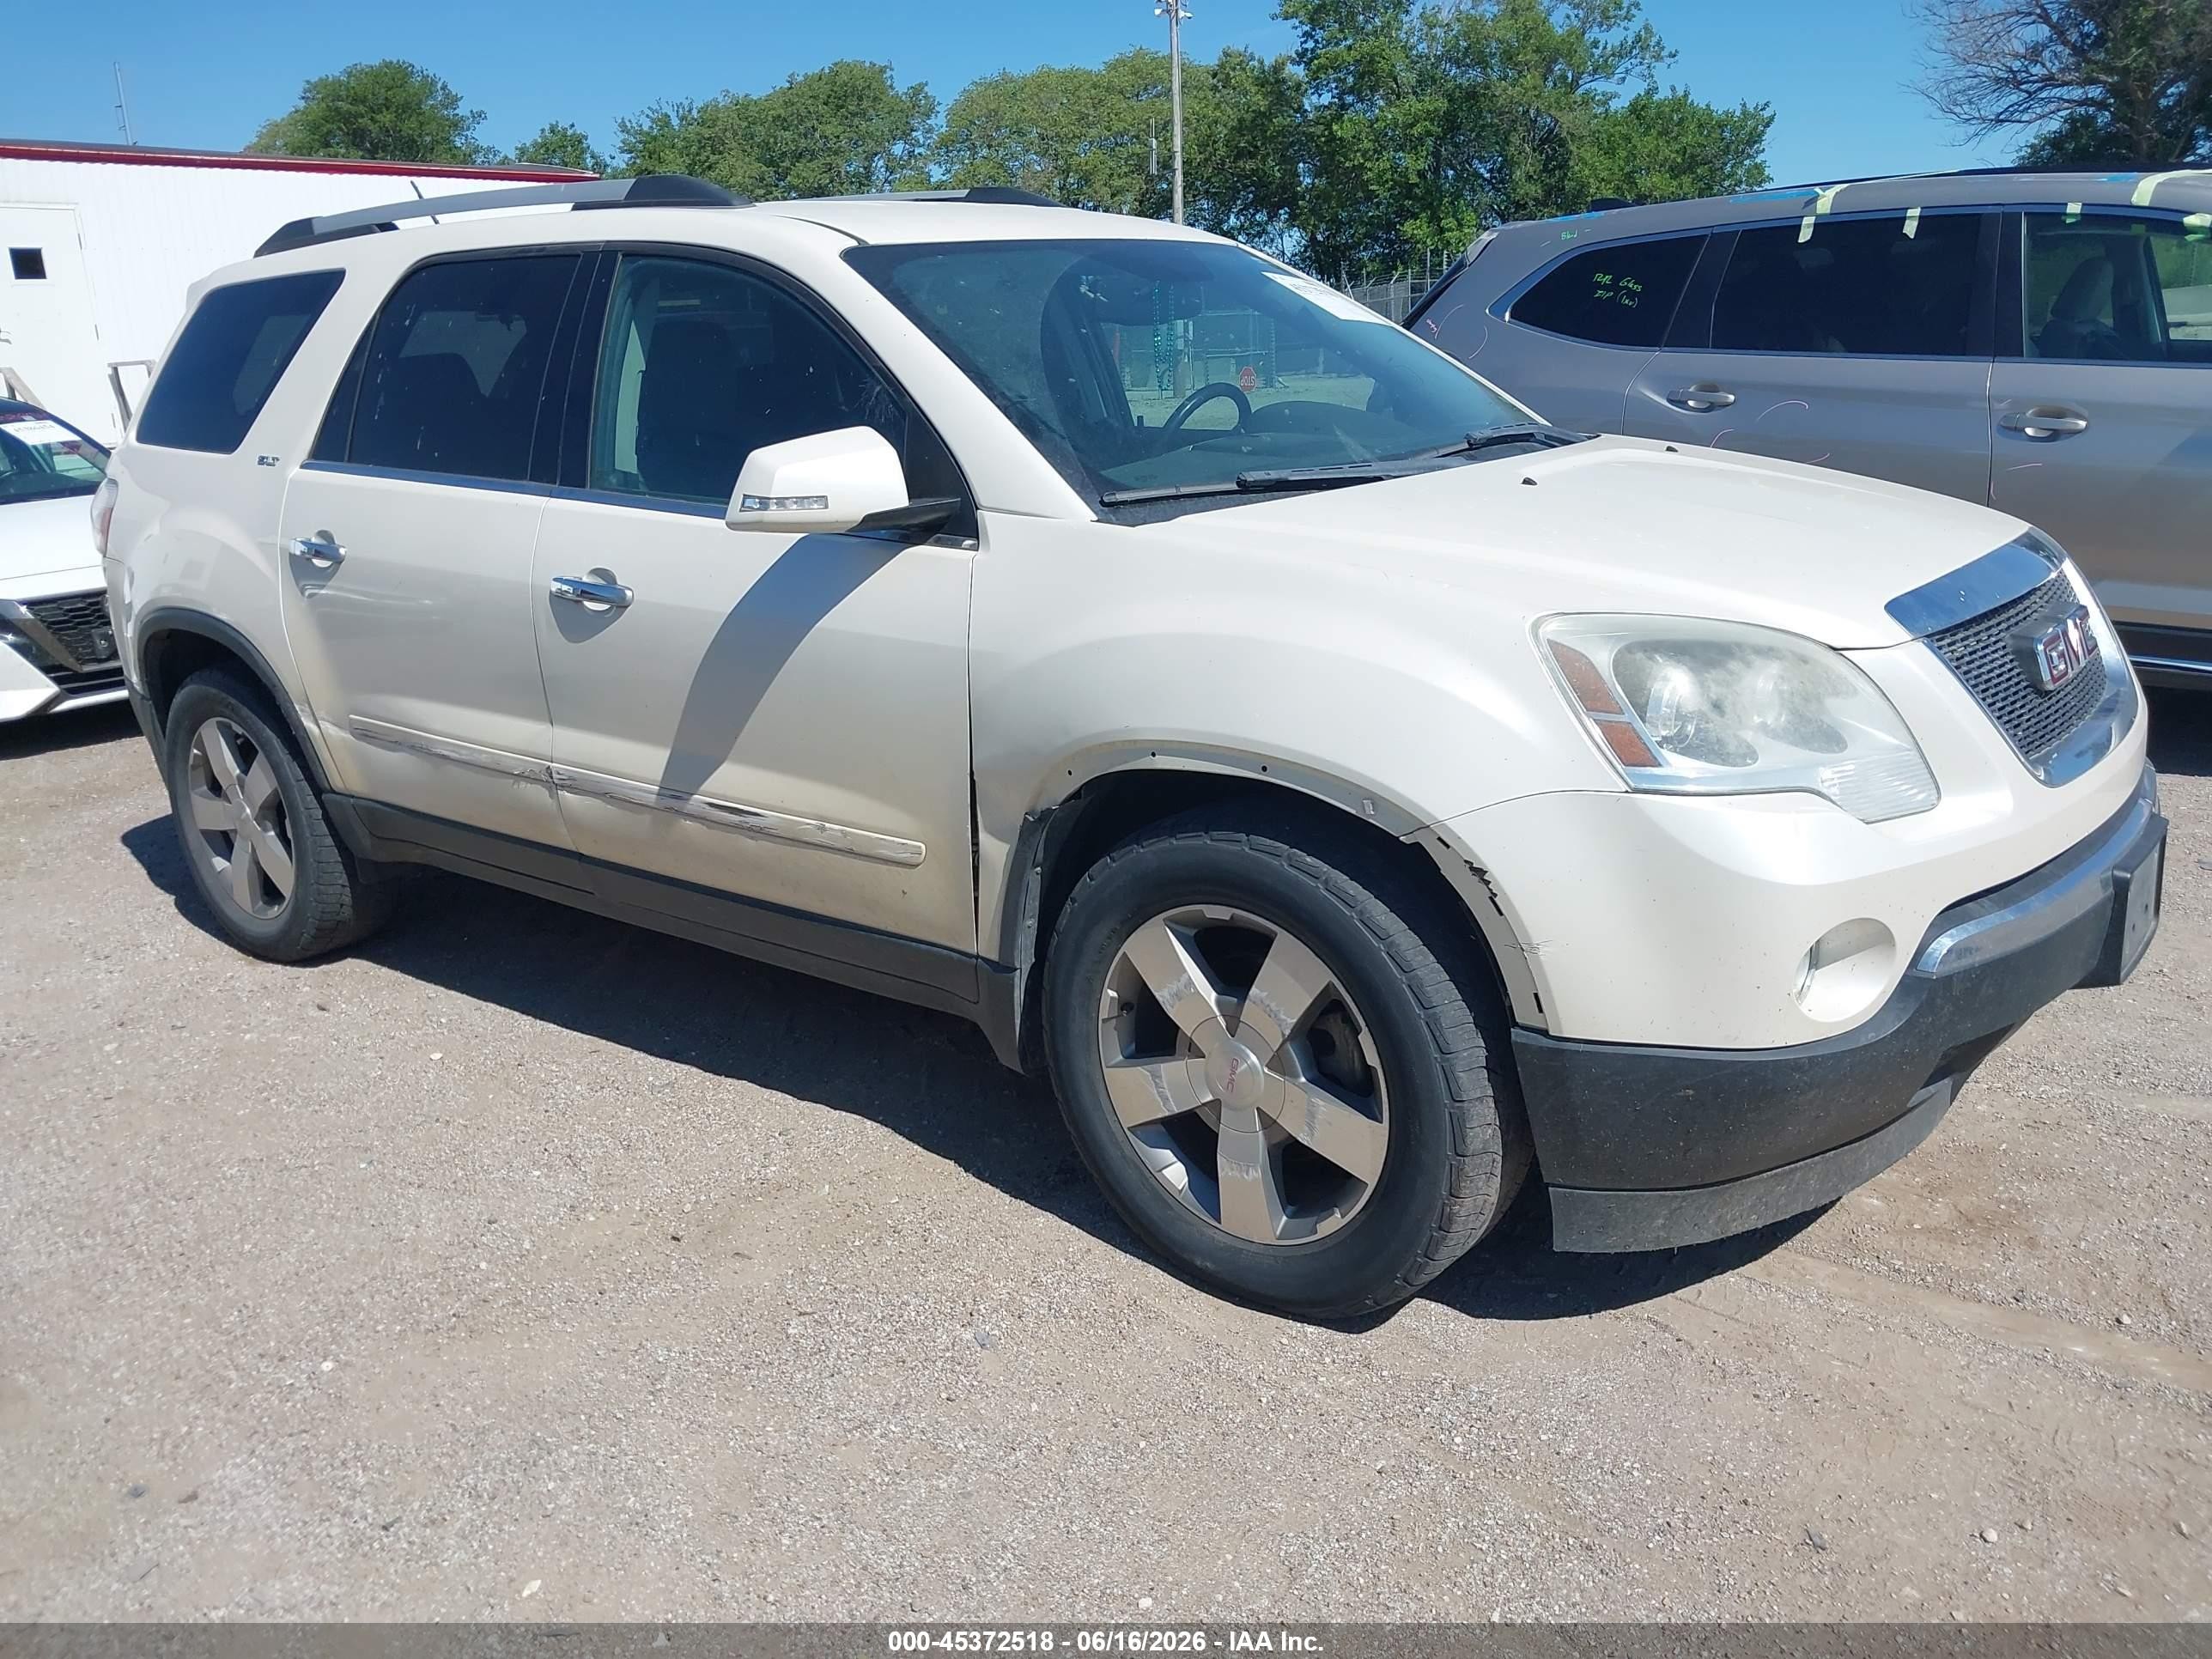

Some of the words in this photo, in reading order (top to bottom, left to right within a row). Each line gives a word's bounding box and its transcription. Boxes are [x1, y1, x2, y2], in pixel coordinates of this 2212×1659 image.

[1619, 276, 1642, 291] Glass
[2033, 605, 2099, 692] GMC
[1225, 1057, 1241, 1093] GMC
